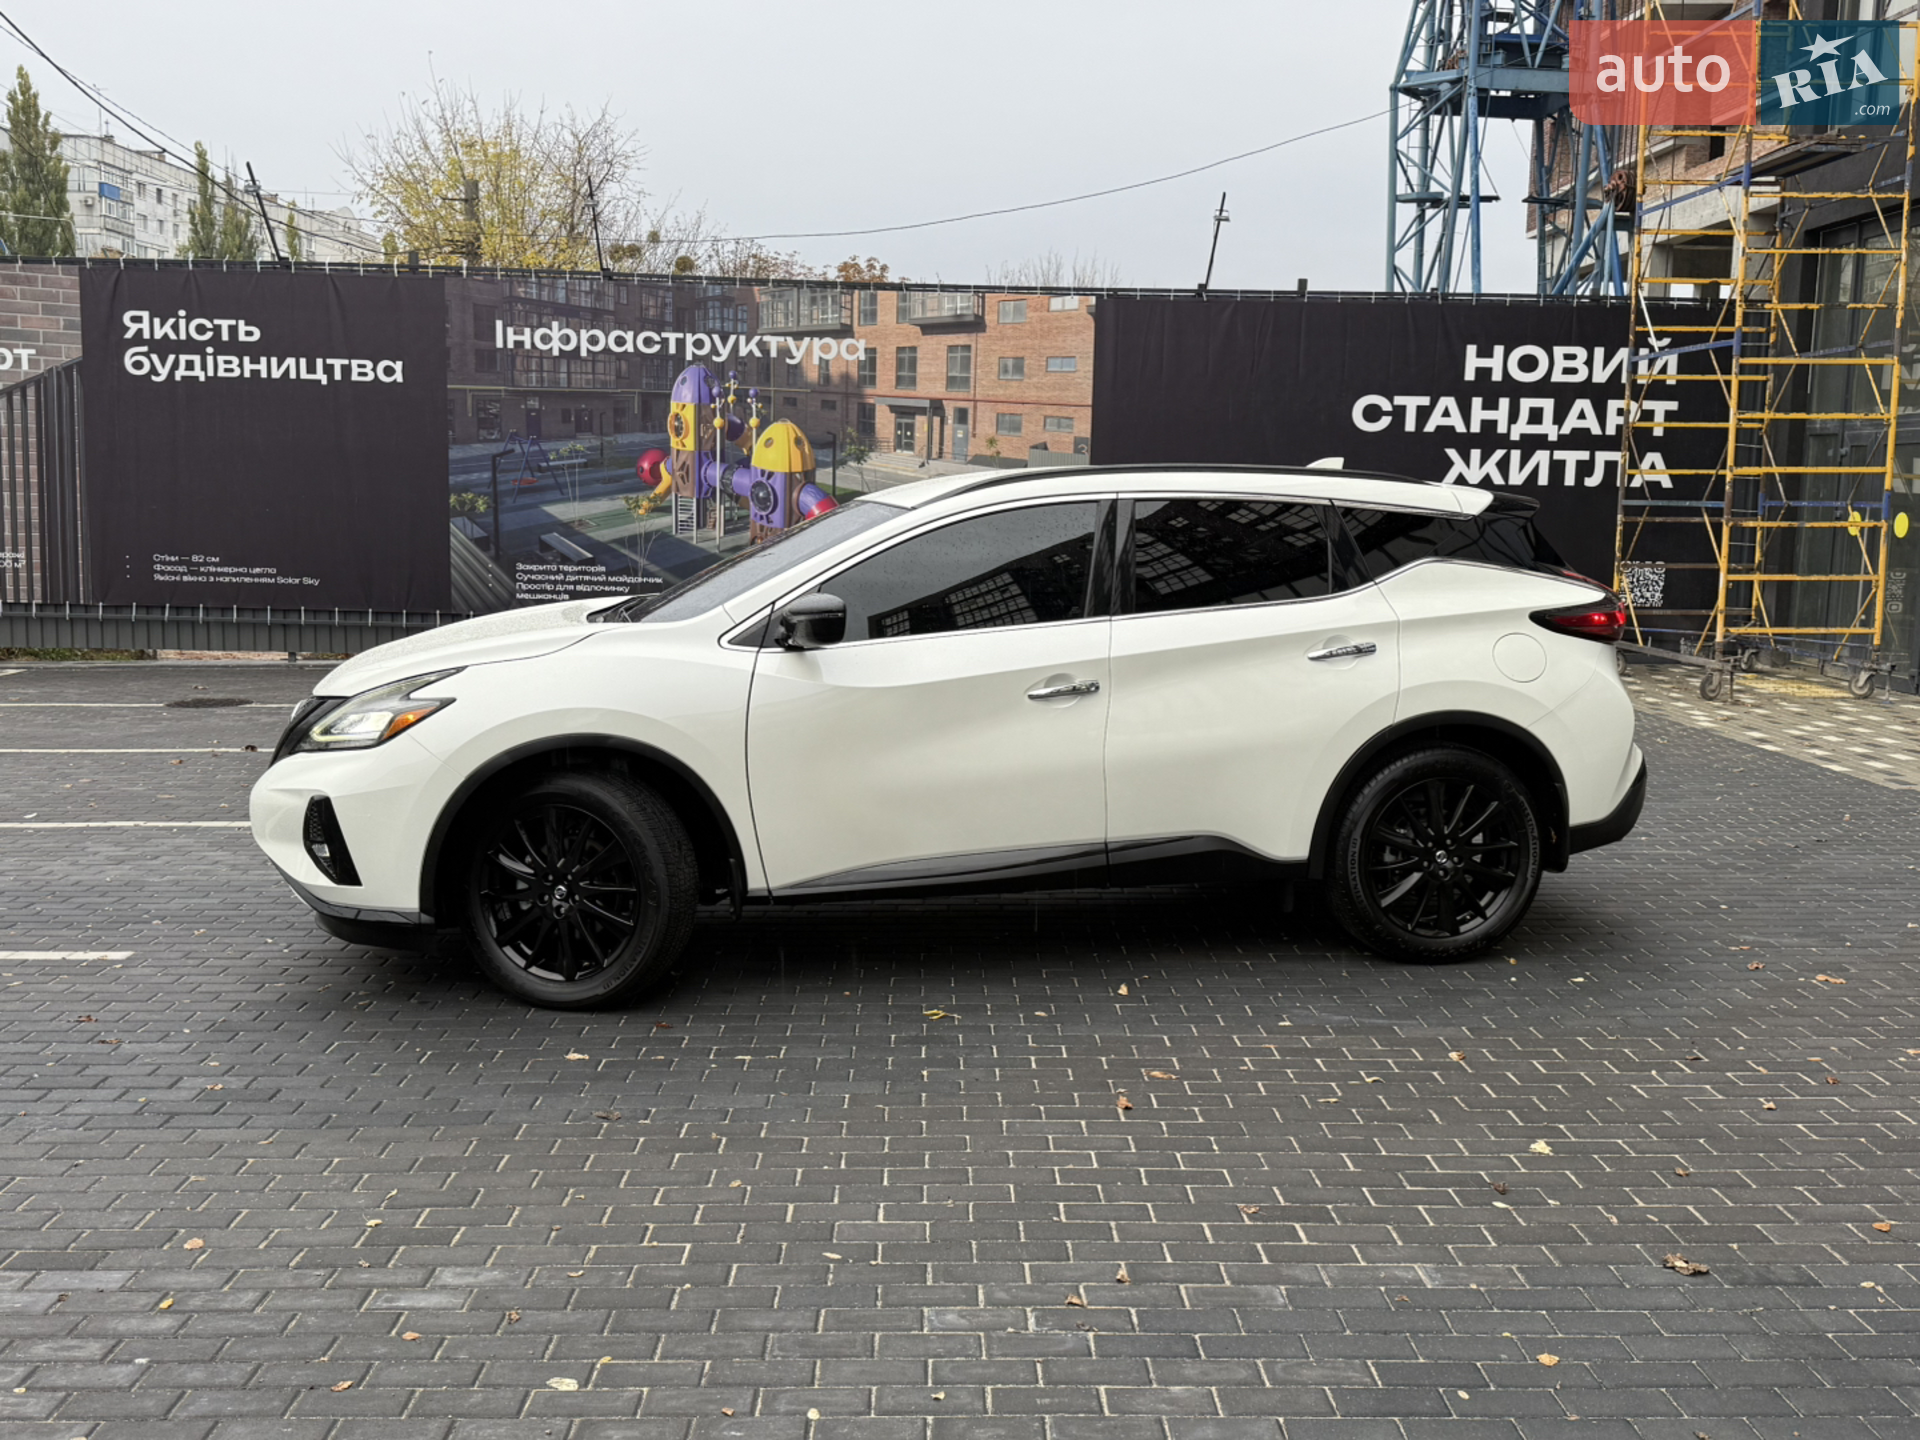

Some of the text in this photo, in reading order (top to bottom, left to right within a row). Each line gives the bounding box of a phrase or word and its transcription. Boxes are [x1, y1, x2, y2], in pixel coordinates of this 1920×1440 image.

[122, 309, 261, 342] Якість
[495, 319, 866, 365] Інфраструктура
[123, 345, 404, 385] будівництва
[1464, 337, 1679, 385] НОВИЙ
[1351, 394, 1679, 441] СТАНДАРТ
[1441, 448, 1674, 489] ЖИТЛА
[153, 554, 179, 562] Стіни
[153, 564, 188, 573] Фасад
[200, 565, 248, 574] клінкерна
[249, 567, 277, 575] цегла
[515, 562, 606, 573] Закрита територія
[182, 574, 207, 582] вікна
[215, 576, 275, 584] напиленням
[276, 576, 301, 585] Solar
[302, 577, 321, 586] Sky
[515, 572, 663, 584] Сучасний дитячий майданчик
[515, 582, 630, 594] Простір для відпочинку
[515, 592, 570, 600] мешканців
